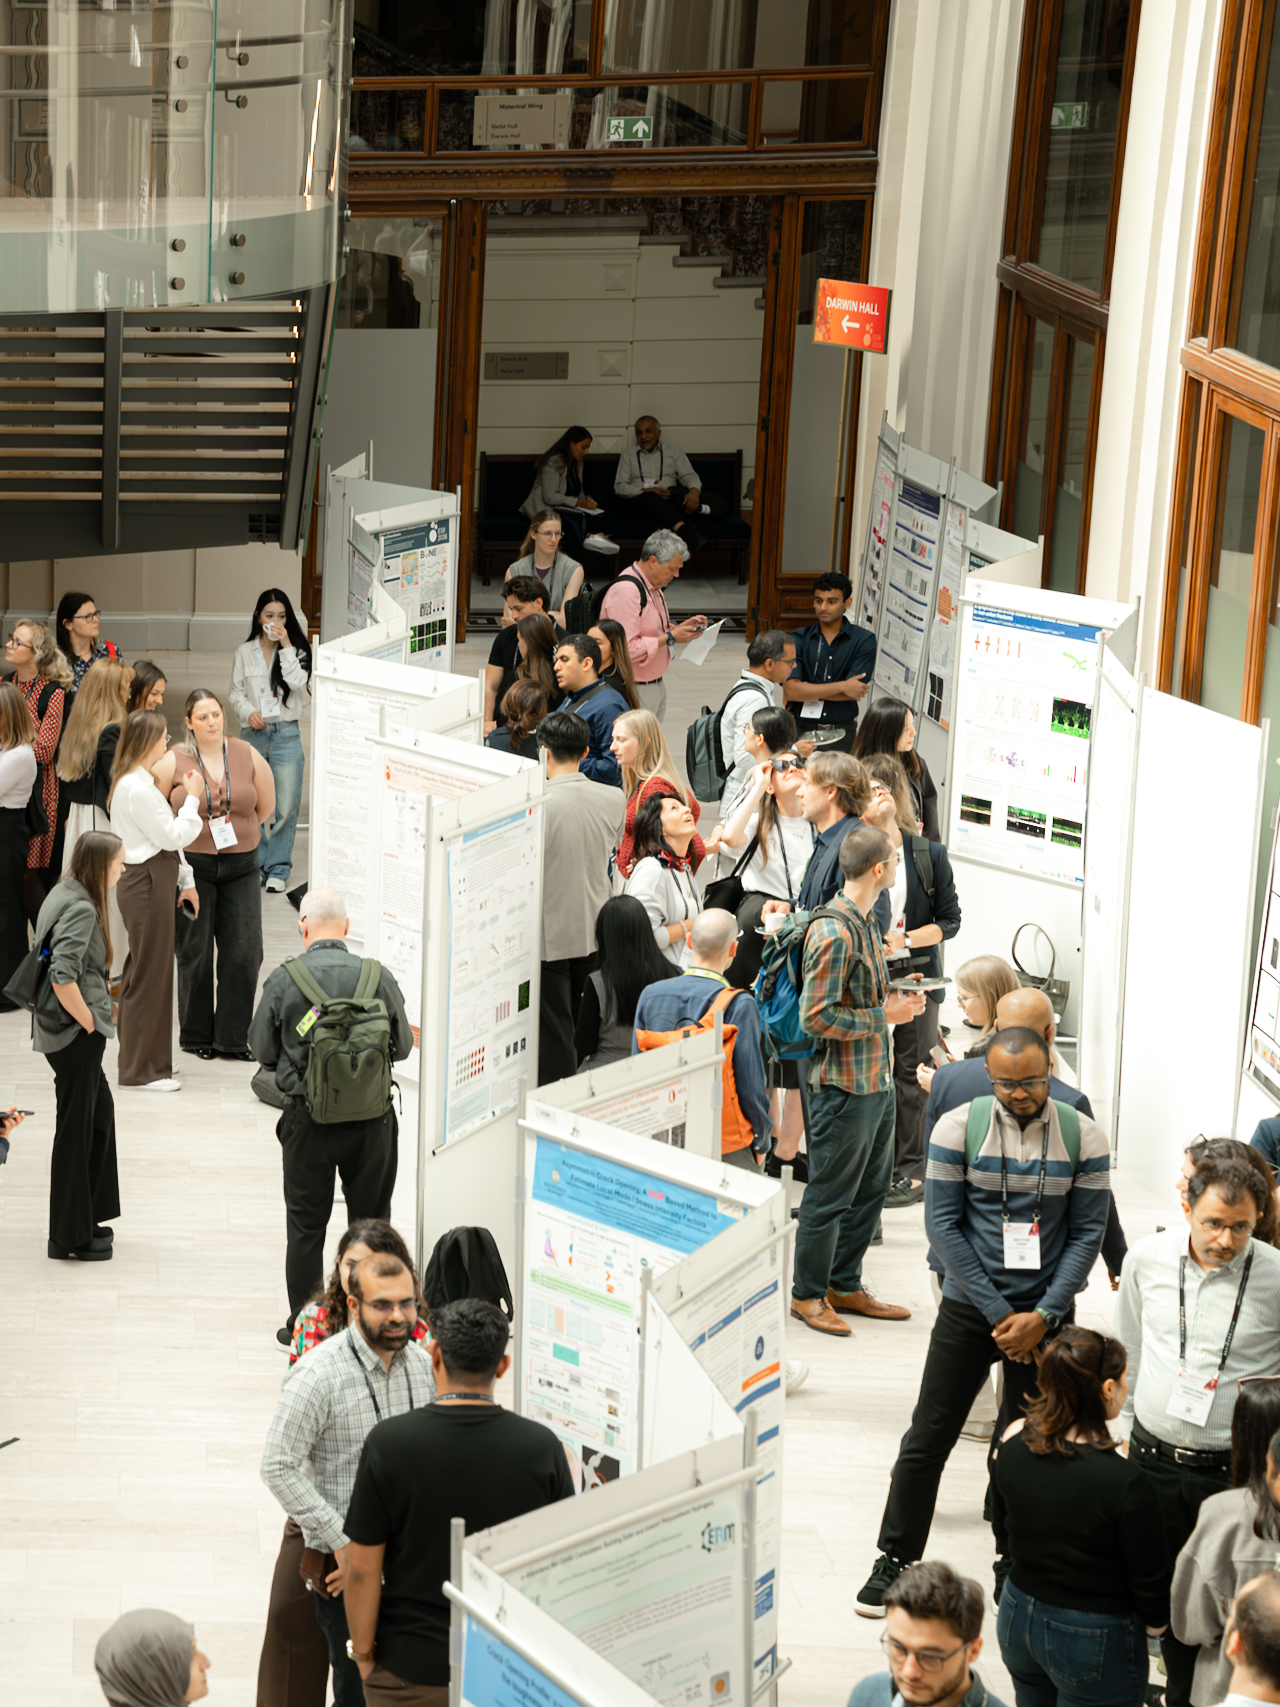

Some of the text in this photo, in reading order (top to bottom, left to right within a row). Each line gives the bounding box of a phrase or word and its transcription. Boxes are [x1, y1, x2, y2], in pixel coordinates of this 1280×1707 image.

[528, 102, 544, 110] Wing
[825, 296, 879, 316] DARWIN HALL
[562, 1159, 596, 1178] Asymmetric
[596, 1171, 614, 1184] Crack
[647, 1188, 665, 1201] COP
[665, 1195, 685, 1209] Based
[686, 1203, 710, 1218] Method
[710, 1212, 717, 1220] to
[570, 1174, 595, 1189] Estimate
[596, 1183, 613, 1195] Local
[614, 1189, 631, 1201] Mode
[635, 1196, 654, 1210] Stress
[655, 1204, 681, 1220] Intensity
[683, 1214, 706, 1228] Factors
